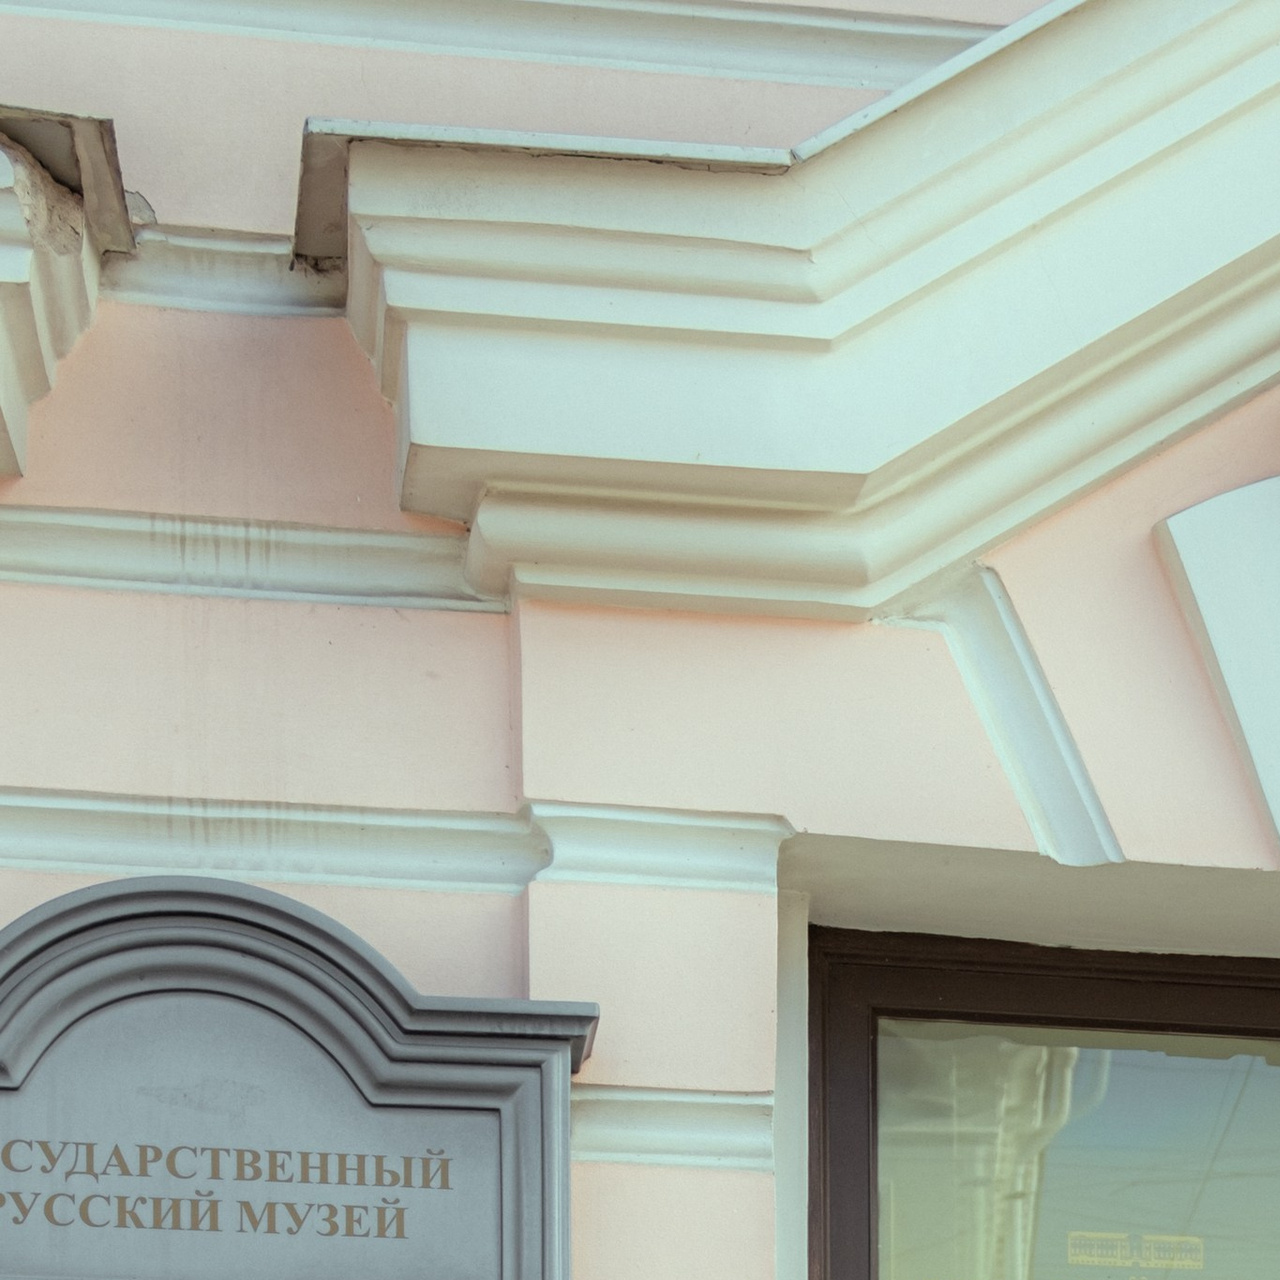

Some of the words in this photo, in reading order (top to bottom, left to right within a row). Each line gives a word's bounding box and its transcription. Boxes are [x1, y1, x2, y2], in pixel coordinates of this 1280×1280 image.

[1, 1139, 454, 1190] СУДАРСТВЕННЫЙ
[0, 1190, 223, 1232] УССКИЙ
[236, 1198, 409, 1239] МУЗЕЙ
